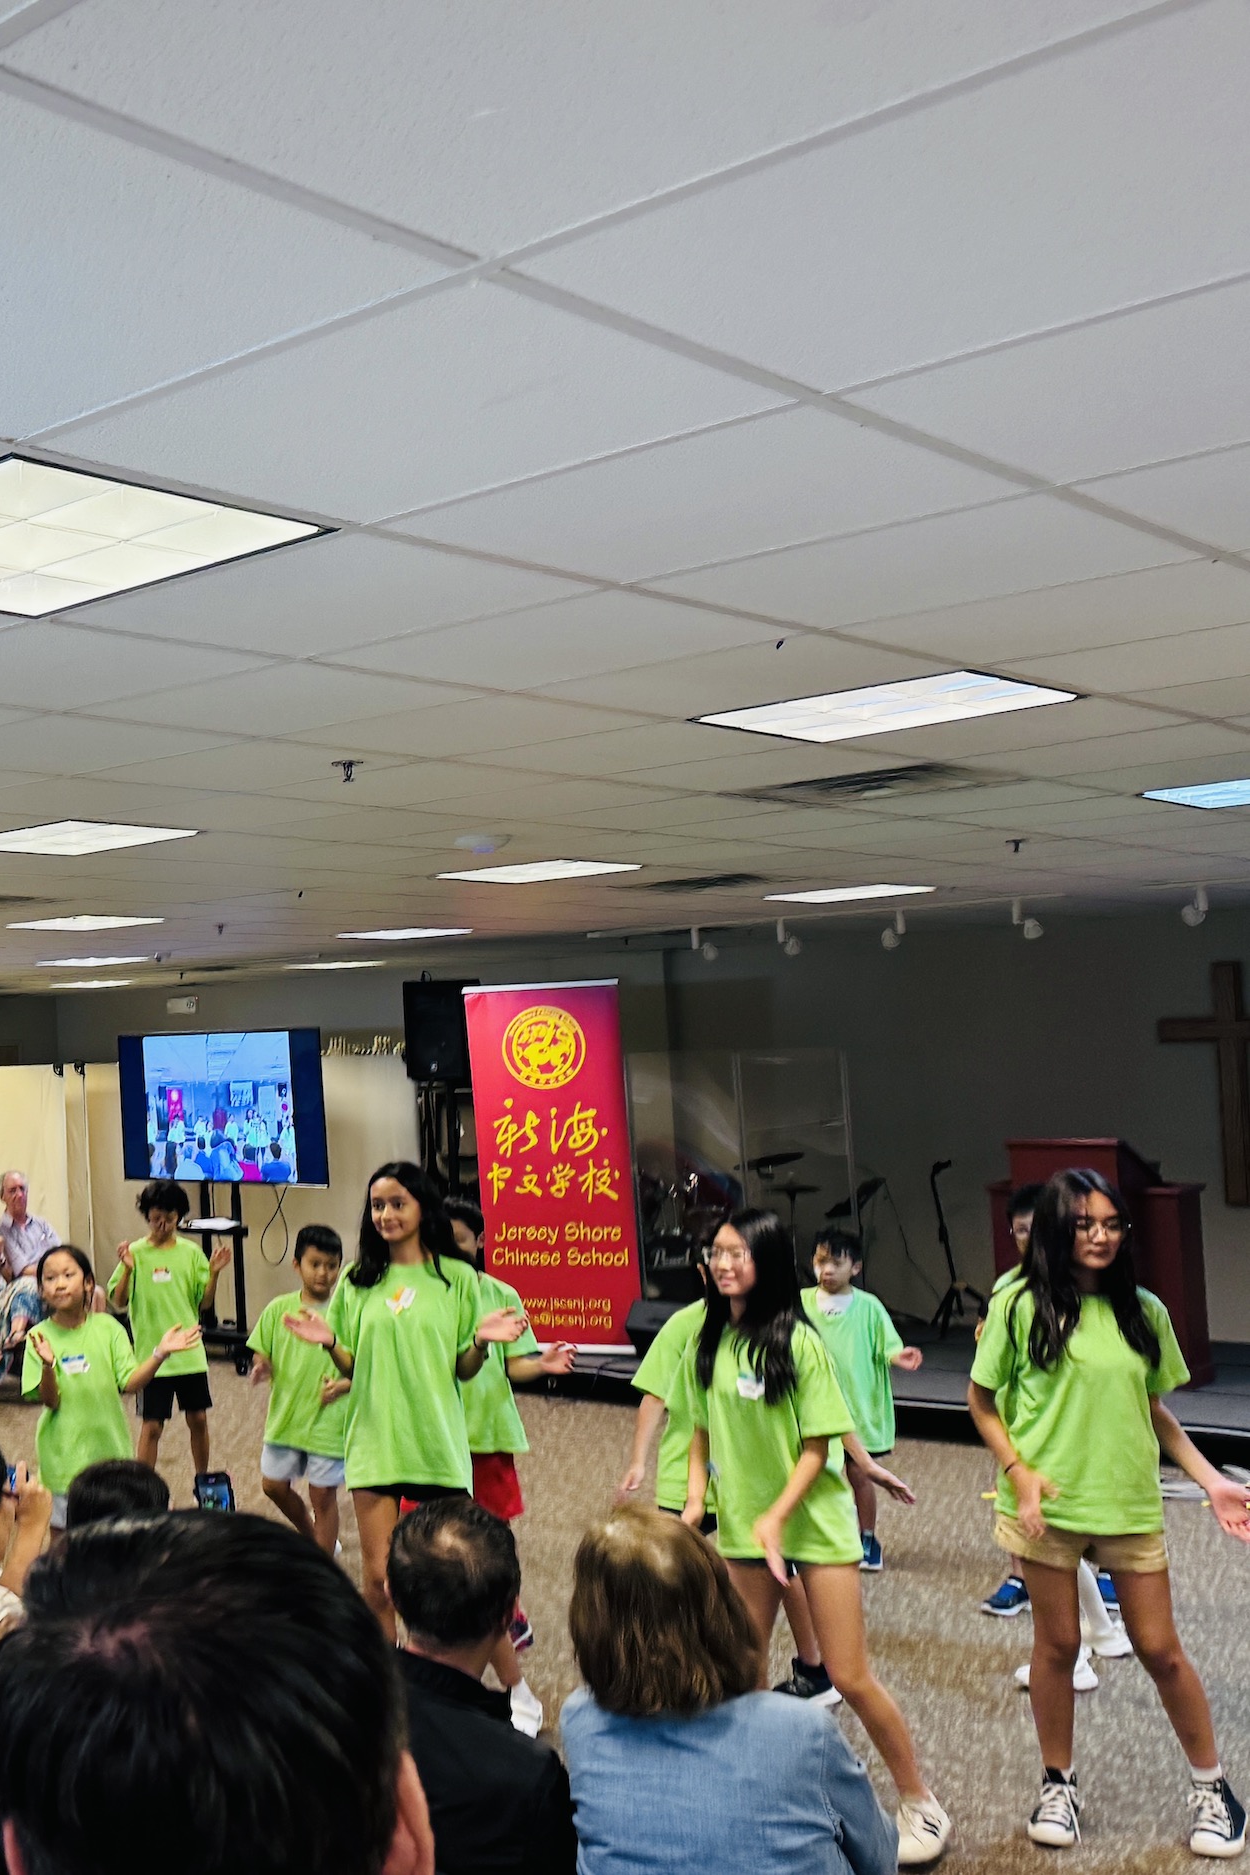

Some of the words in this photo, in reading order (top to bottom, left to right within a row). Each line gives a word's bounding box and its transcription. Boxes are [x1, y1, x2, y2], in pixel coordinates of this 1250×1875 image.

[487, 1159, 620, 1206] 中文学校
[494, 1222, 559, 1245] Jersey
[564, 1220, 622, 1242] Shore
[492, 1246, 561, 1267] Chinese
[566, 1246, 629, 1267] School
